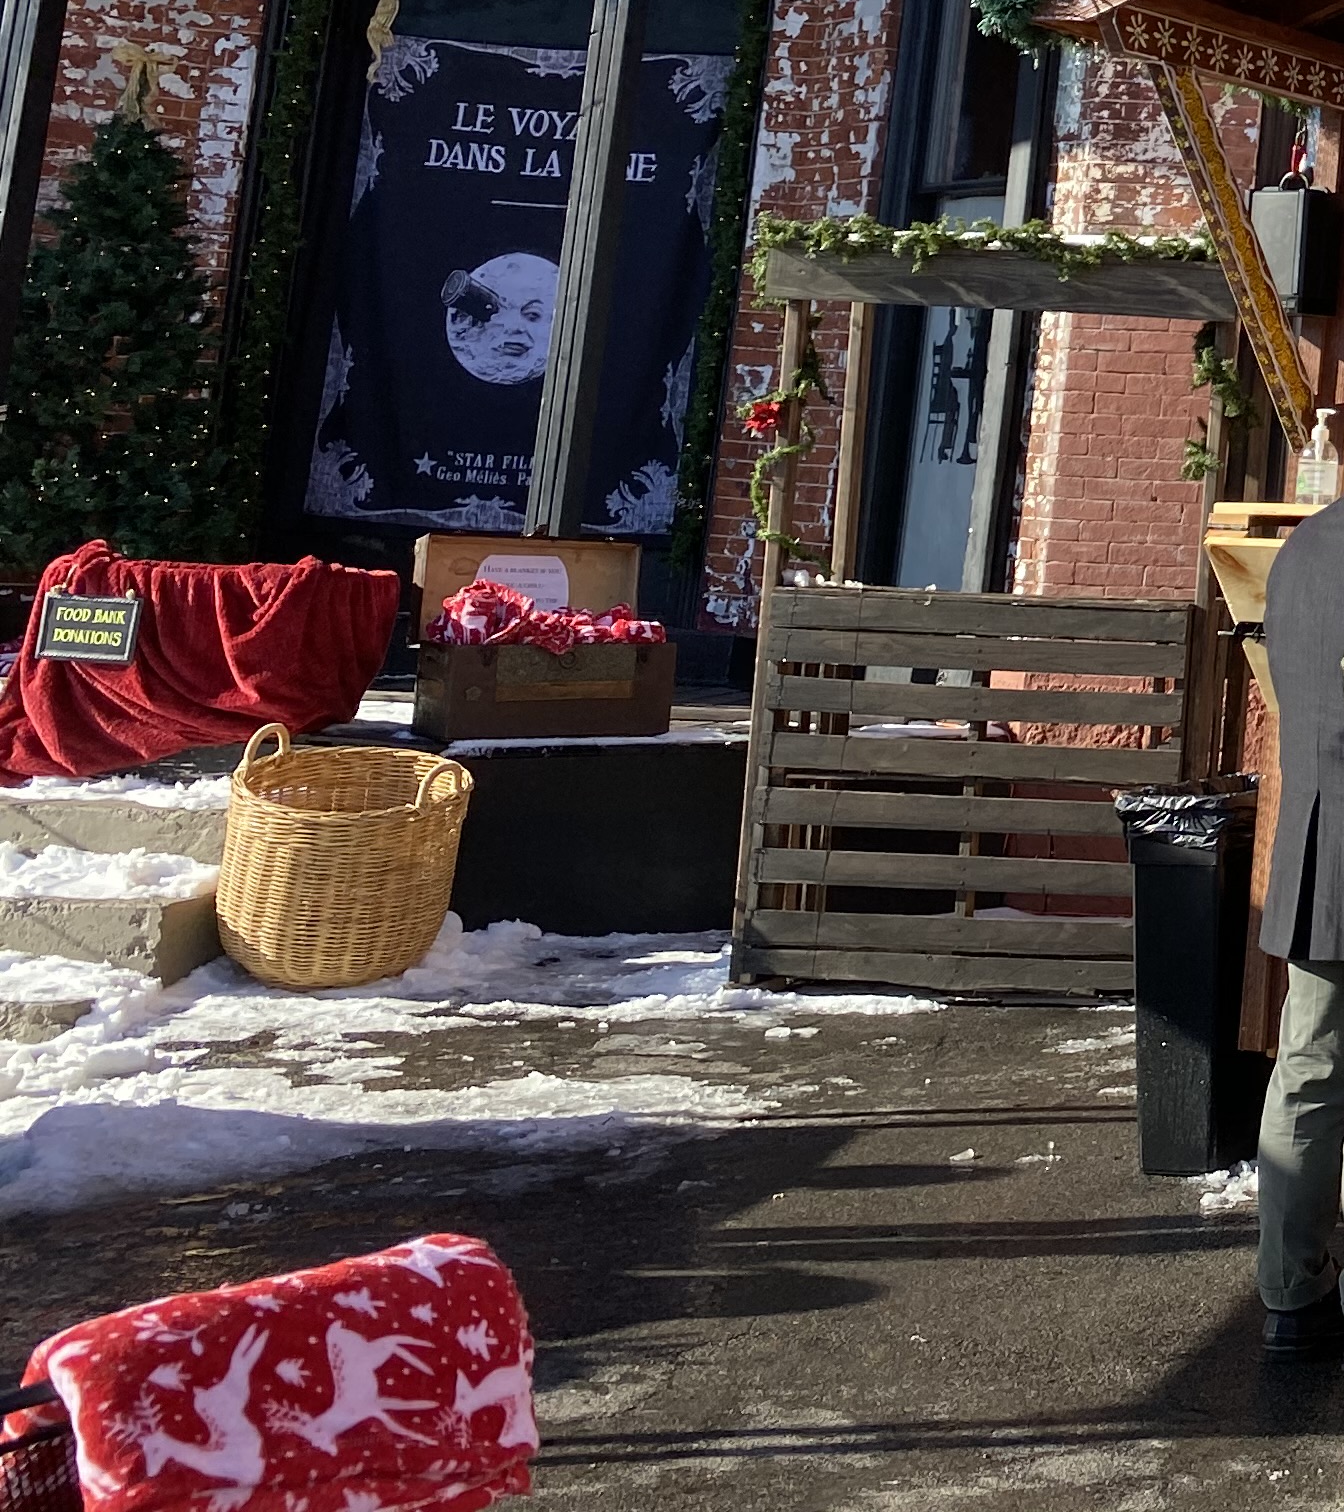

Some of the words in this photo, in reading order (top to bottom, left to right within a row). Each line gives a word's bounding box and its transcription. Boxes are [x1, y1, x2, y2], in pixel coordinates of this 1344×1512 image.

[451, 102, 495, 134] LE
[424, 139, 506, 174] DANS
[520, 149, 562, 178] LA
[436, 466, 461, 481] Geo
[56, 607, 91, 622] FOOD
[92, 608, 126, 625] BANK
[52, 628, 122, 647] DONATIONS
